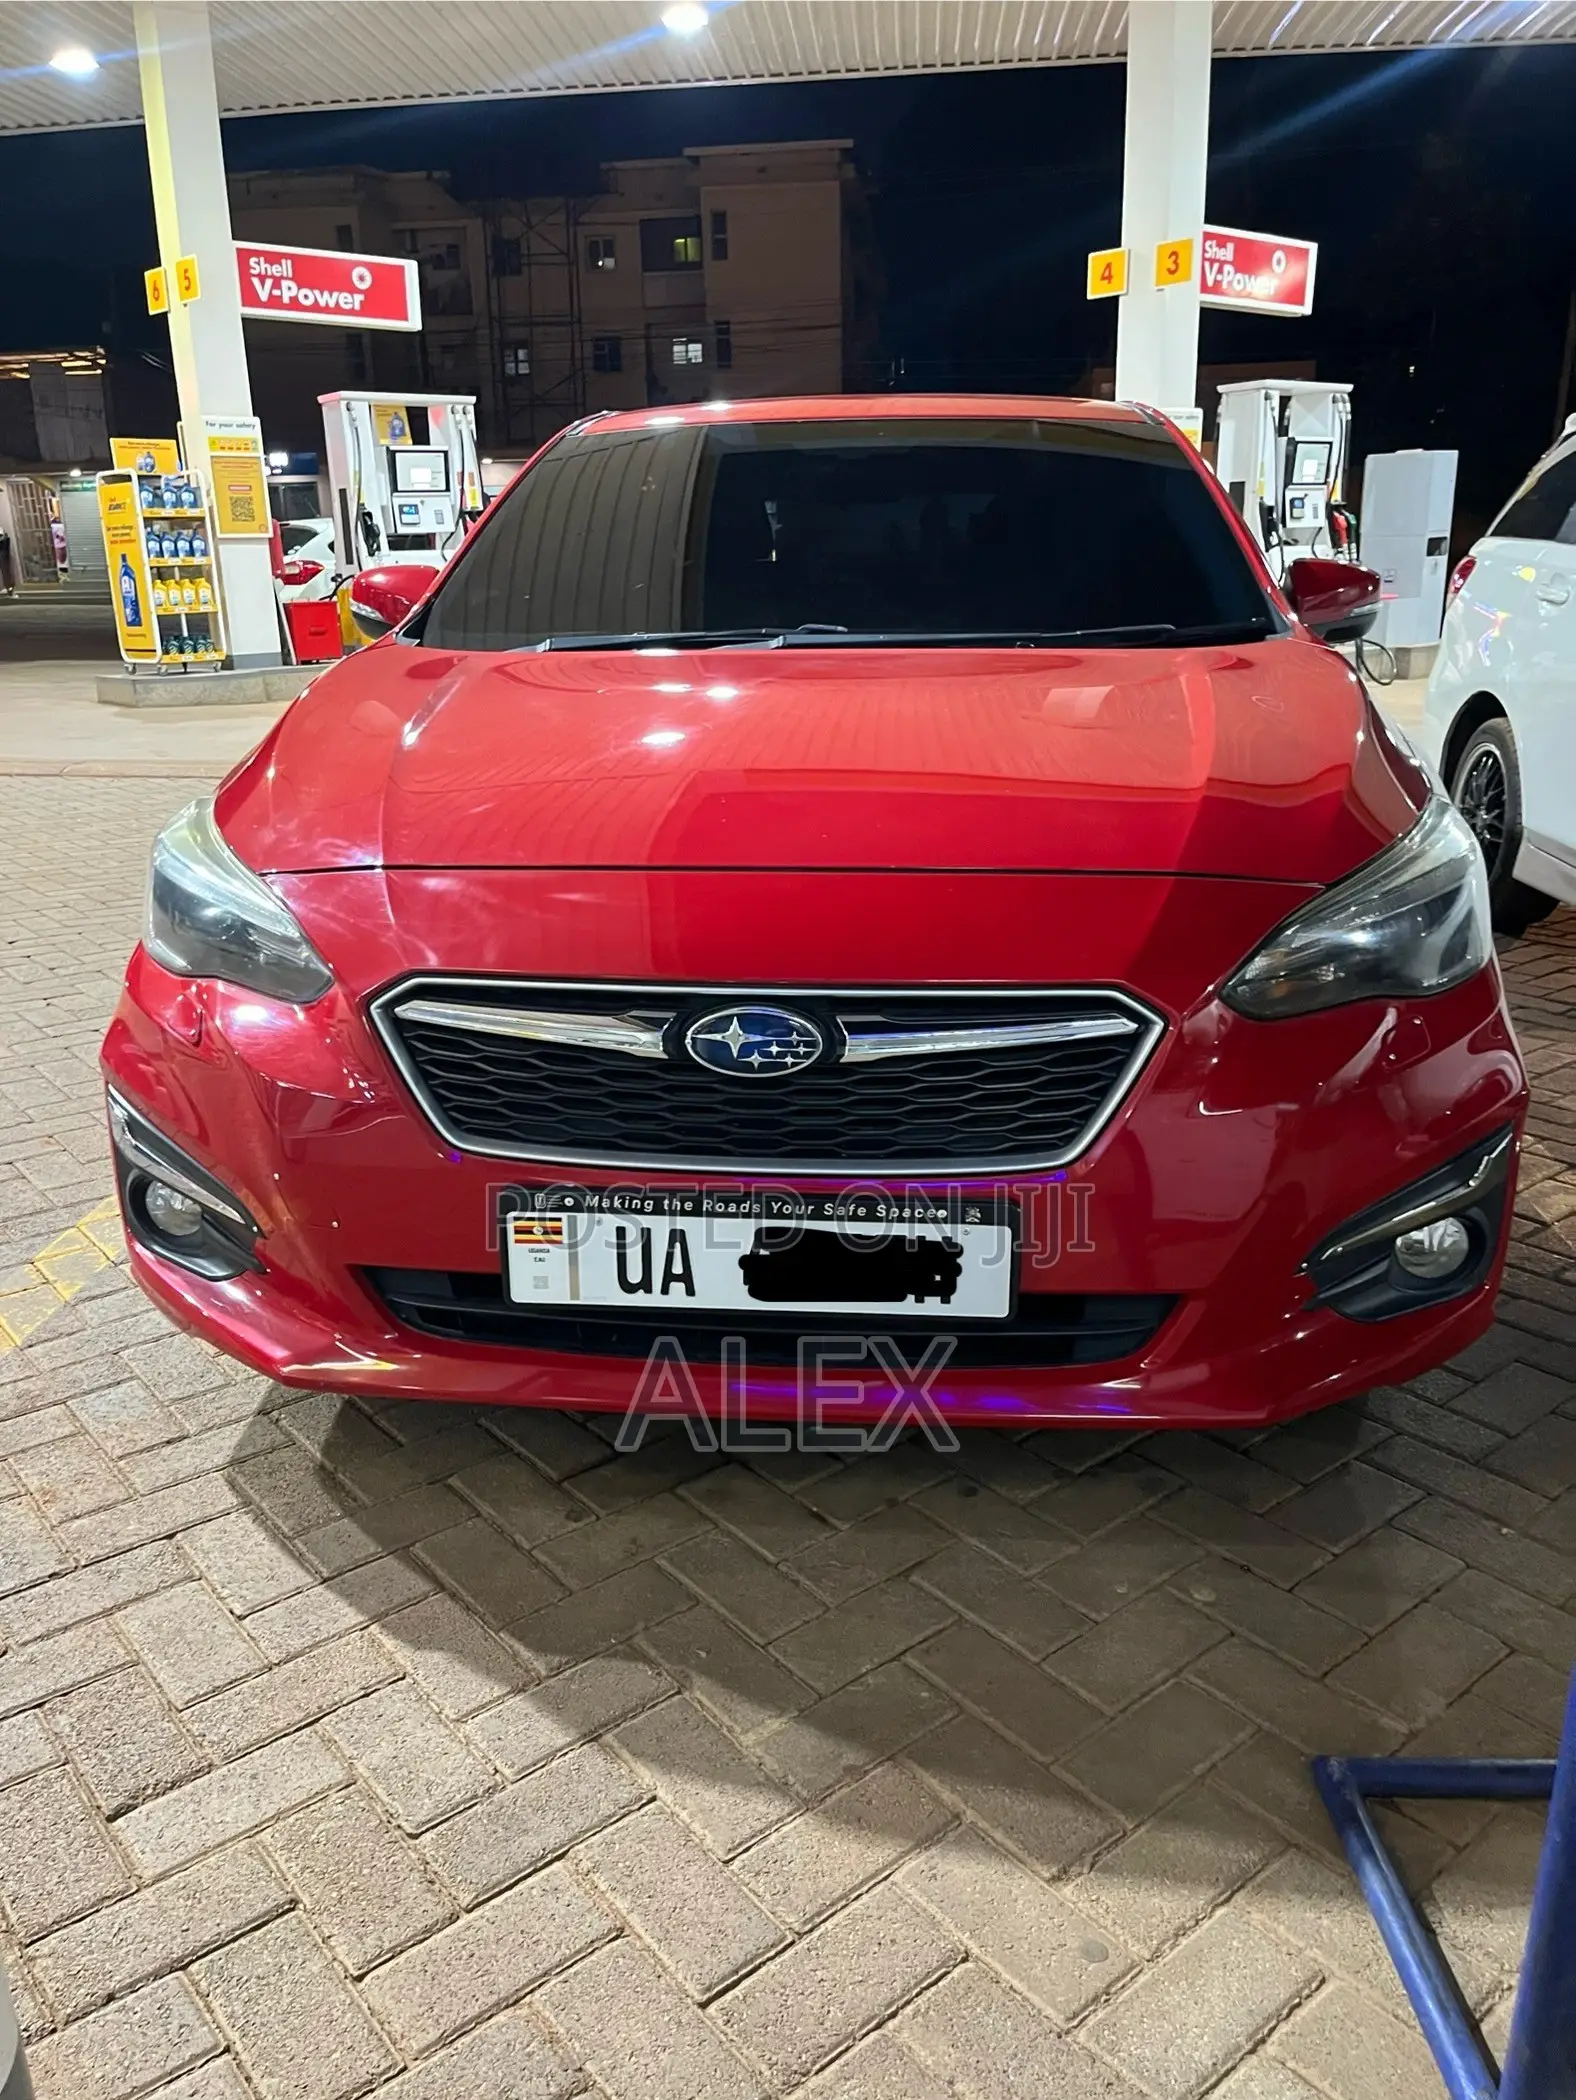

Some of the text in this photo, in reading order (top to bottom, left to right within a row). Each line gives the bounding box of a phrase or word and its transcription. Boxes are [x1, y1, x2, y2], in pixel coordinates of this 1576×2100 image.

[1204, 240, 1234, 261] Shell
[248, 256, 293, 278] Shell
[1100, 262, 1114, 284] 4
[1166, 250, 1180, 276] 3
[152, 279, 161, 302] 6
[183, 268, 192, 292] 5
[1203, 261, 1277, 297] V-Power
[251, 277, 365, 311] V-Power
[585, 1195, 654, 1212] Making
[662, 1197, 694, 1212] the
[702, 1199, 761, 1214] Roads
[771, 1202, 815, 1215] Your
[823, 1203, 868, 1217] Safe
[615, 1225, 696, 1298] UA
